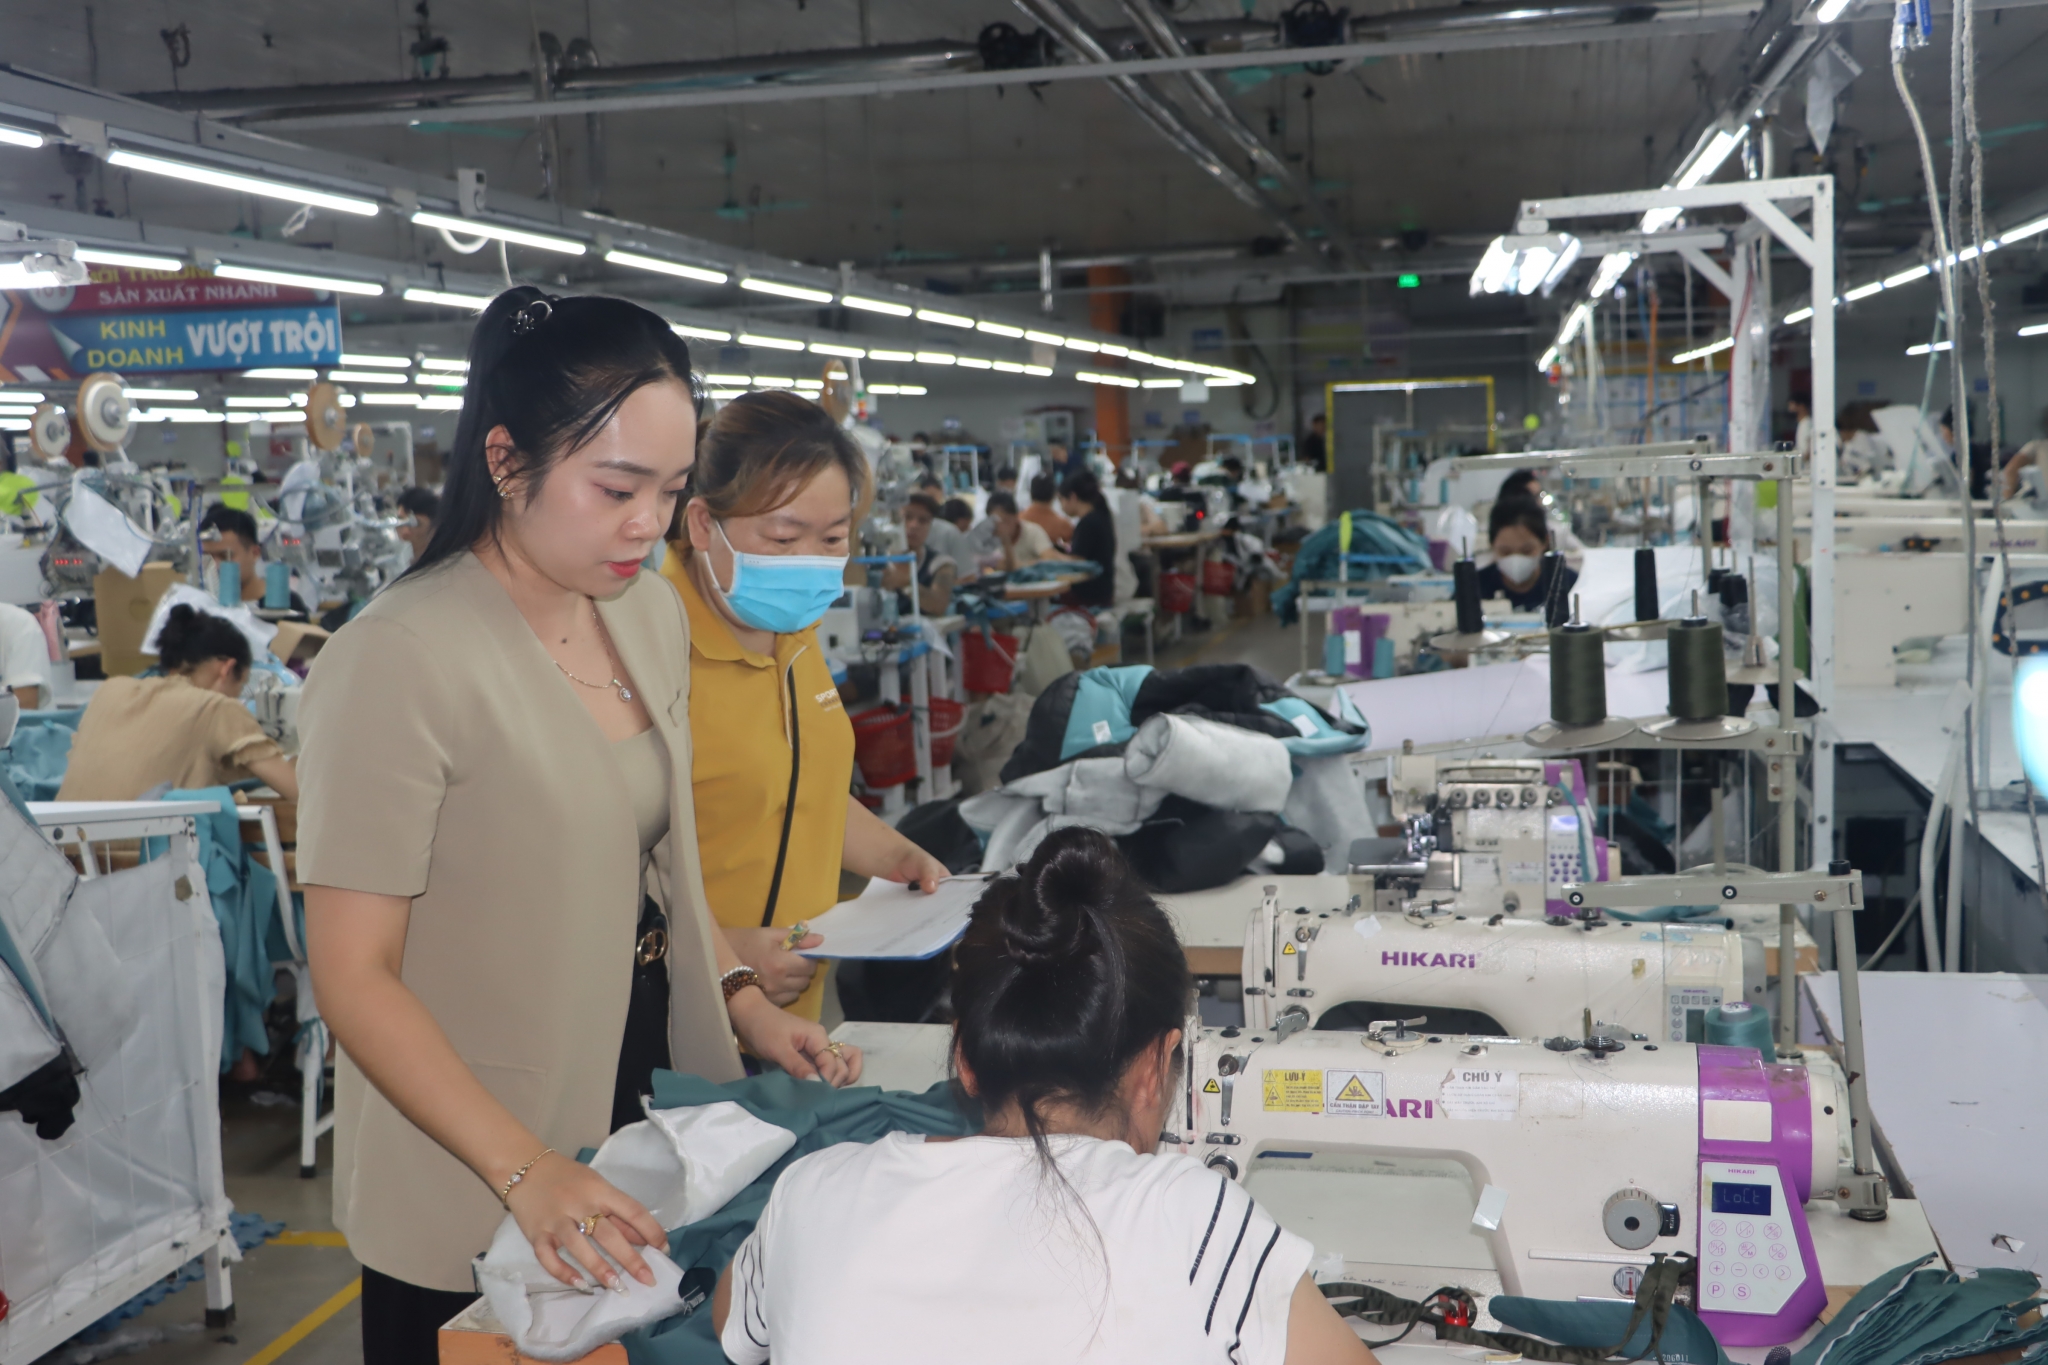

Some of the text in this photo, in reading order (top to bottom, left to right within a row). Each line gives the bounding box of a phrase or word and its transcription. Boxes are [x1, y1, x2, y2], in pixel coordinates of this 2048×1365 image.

[146, 282, 199, 303] XUẤT
[206, 284, 278, 300] NHANH
[101, 319, 167, 340] KINH
[186, 311, 337, 364] VƯỢT TRỘI
[88, 346, 184, 369] DOANH
[1381, 951, 1475, 968] HIKARI
[1462, 1070, 1503, 1082] CHÚ Ý
[1386, 1098, 1433, 1118] ARI
[1712, 1284, 1720, 1295] P
[1737, 1286, 1747, 1297] S
